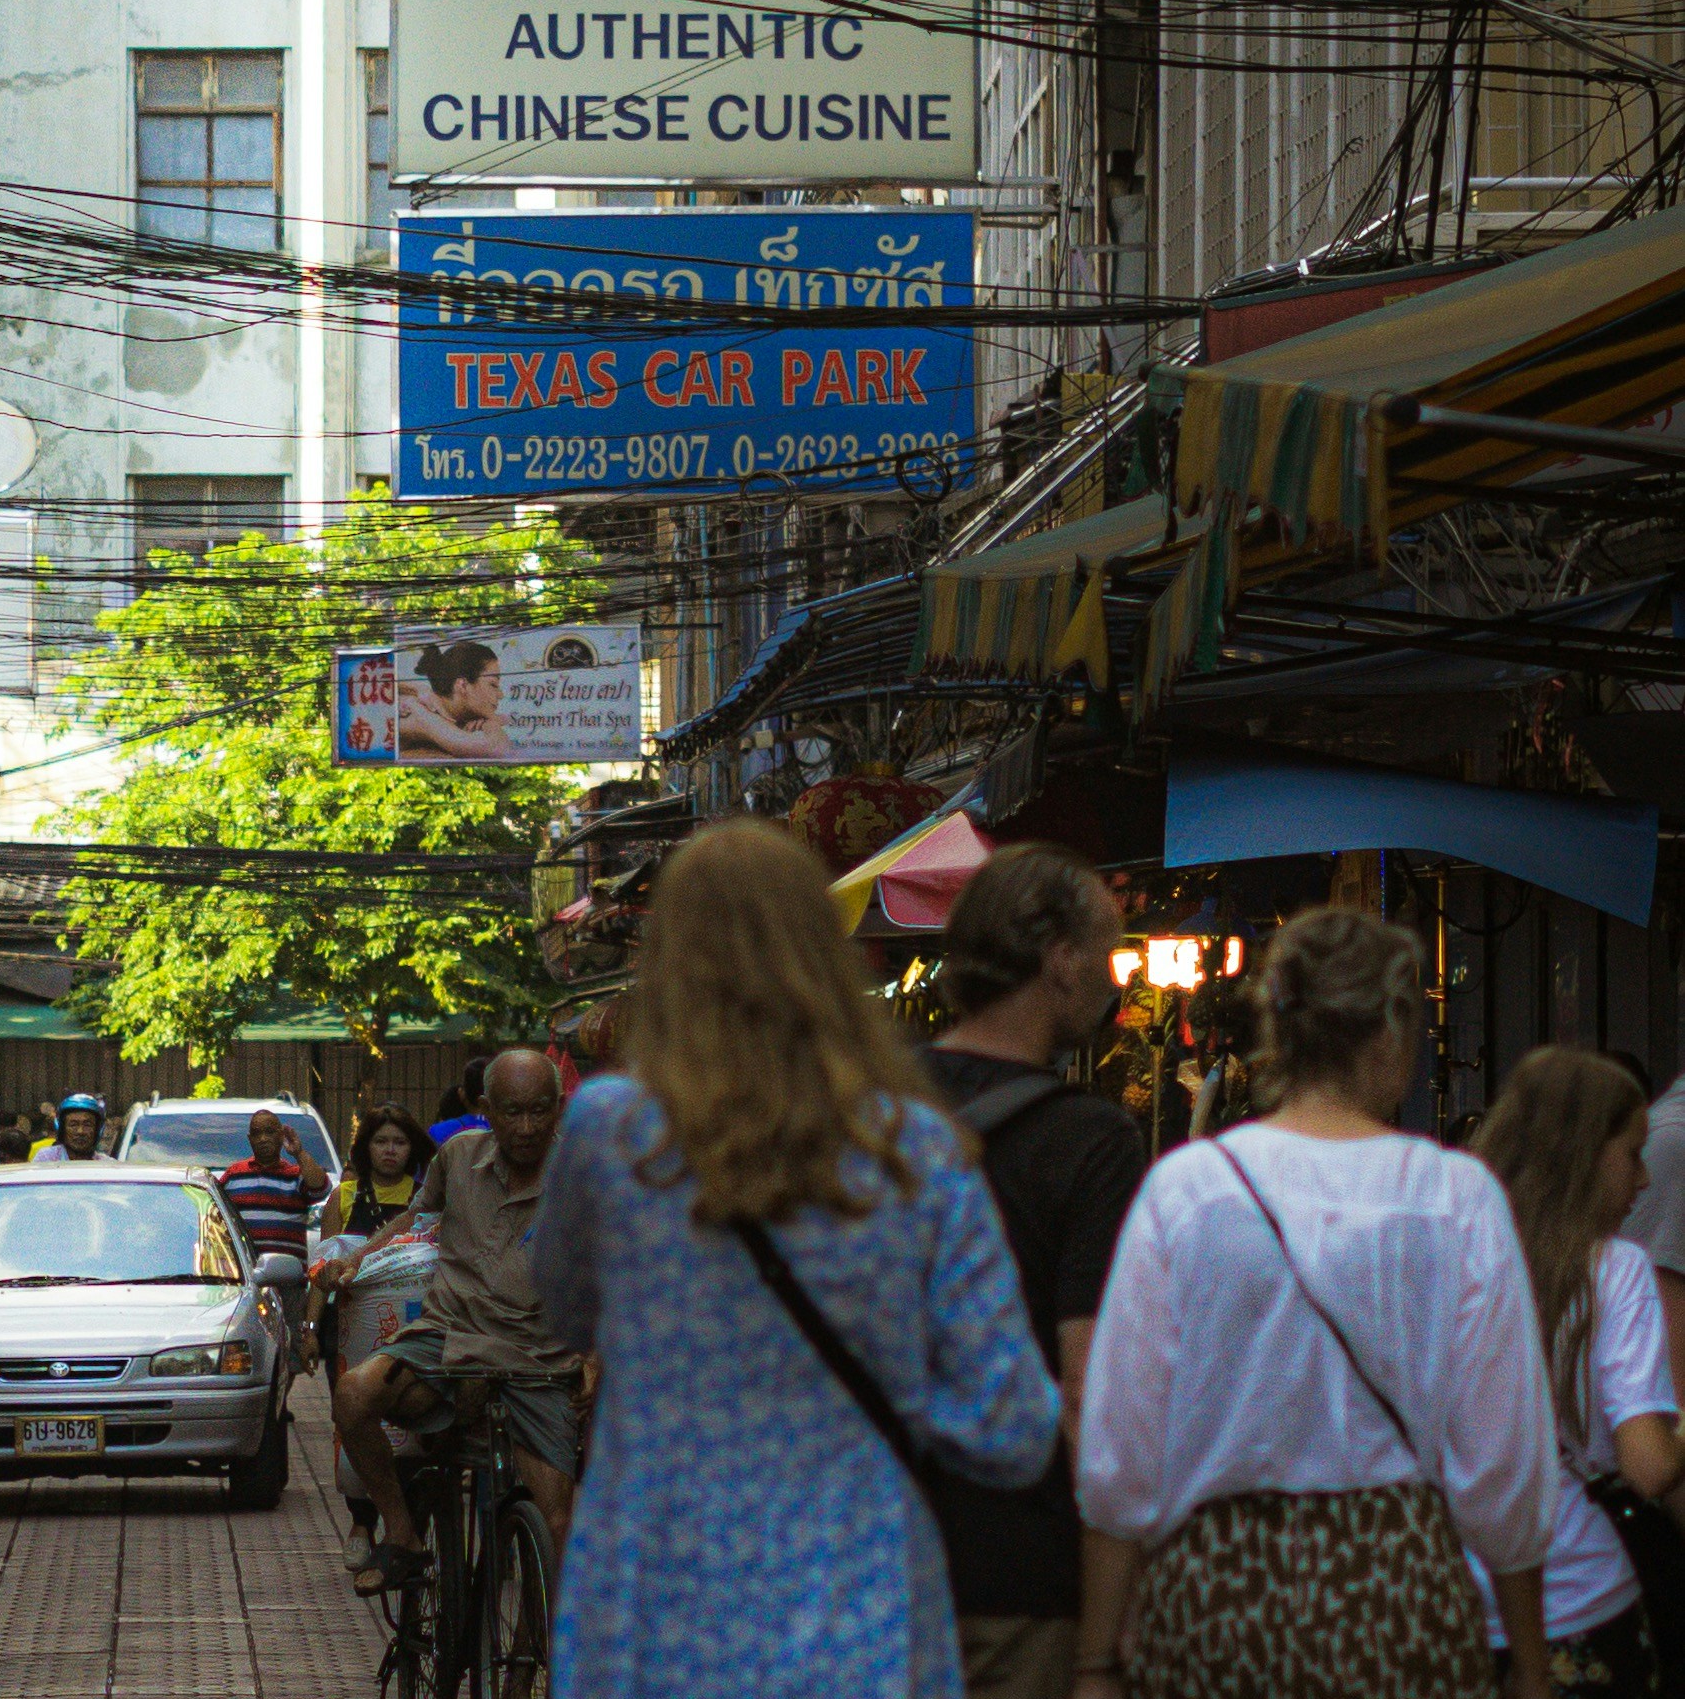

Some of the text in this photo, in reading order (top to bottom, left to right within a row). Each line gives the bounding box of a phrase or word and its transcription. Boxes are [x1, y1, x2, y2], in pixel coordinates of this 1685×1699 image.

[505, 12, 864, 62] AUTHENTIC
[422, 93, 952, 143] CHINESE CUISINE
[447, 348, 930, 411] TEXAS CAR PARK
[415, 434, 475, 481] โทร.
[566, 709, 601, 728] Thai
[605, 711, 632, 734] Spa
